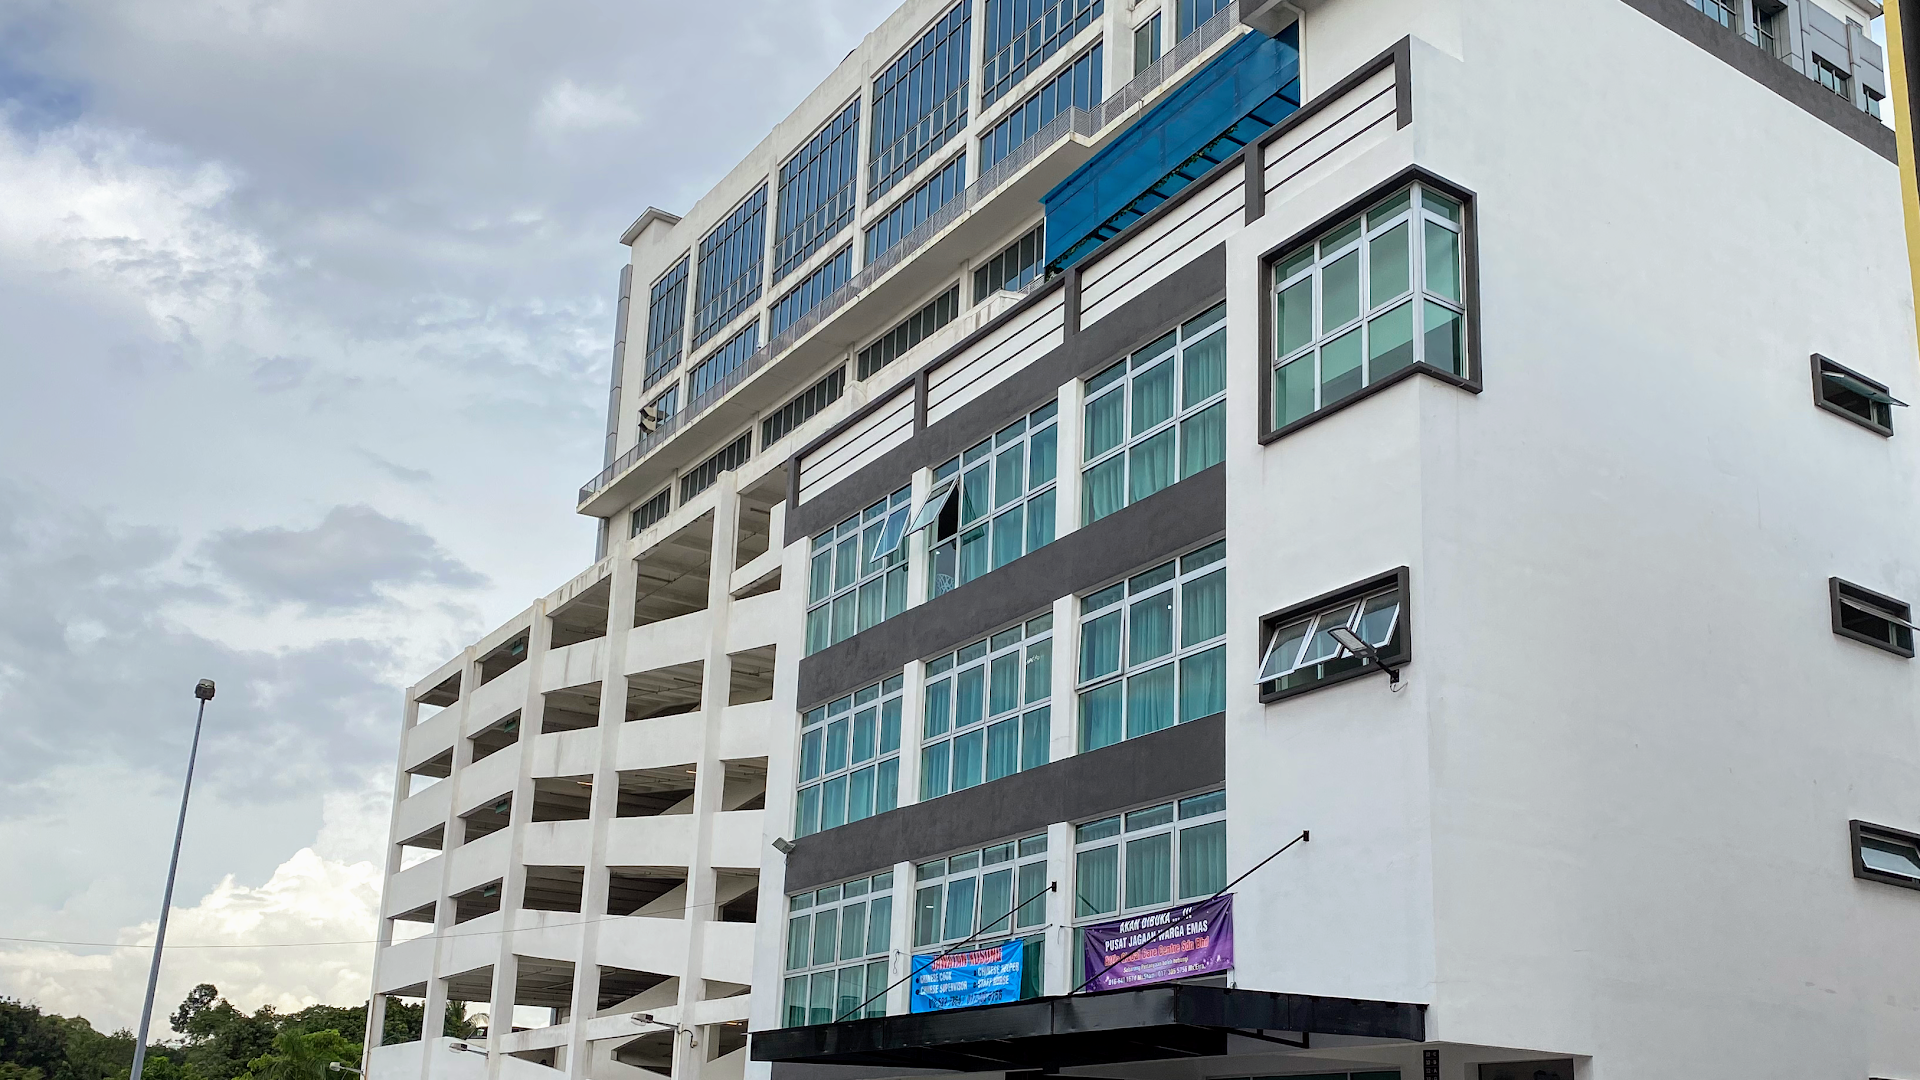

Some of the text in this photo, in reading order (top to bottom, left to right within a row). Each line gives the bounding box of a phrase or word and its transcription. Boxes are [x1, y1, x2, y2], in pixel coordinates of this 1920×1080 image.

[1120, 919, 1140, 933] AKAN
[1142, 912, 1170, 929] DIBUKA
[1105, 920, 1208, 952] PUSAT JAGAAN WARGA EMAS
[1142, 948, 1158, 959] Care
[1158, 942, 1180, 955] Centre
[1181, 939, 1194, 951] Sdn
[1195, 935, 1209, 949] Bhd
[920, 971, 953, 984] CHINESE COOK
[978, 966, 1000, 977] CHINESE
[920, 981, 968, 994] CHINESE SUPERVISOR
[977, 978, 992, 988] STAFF
